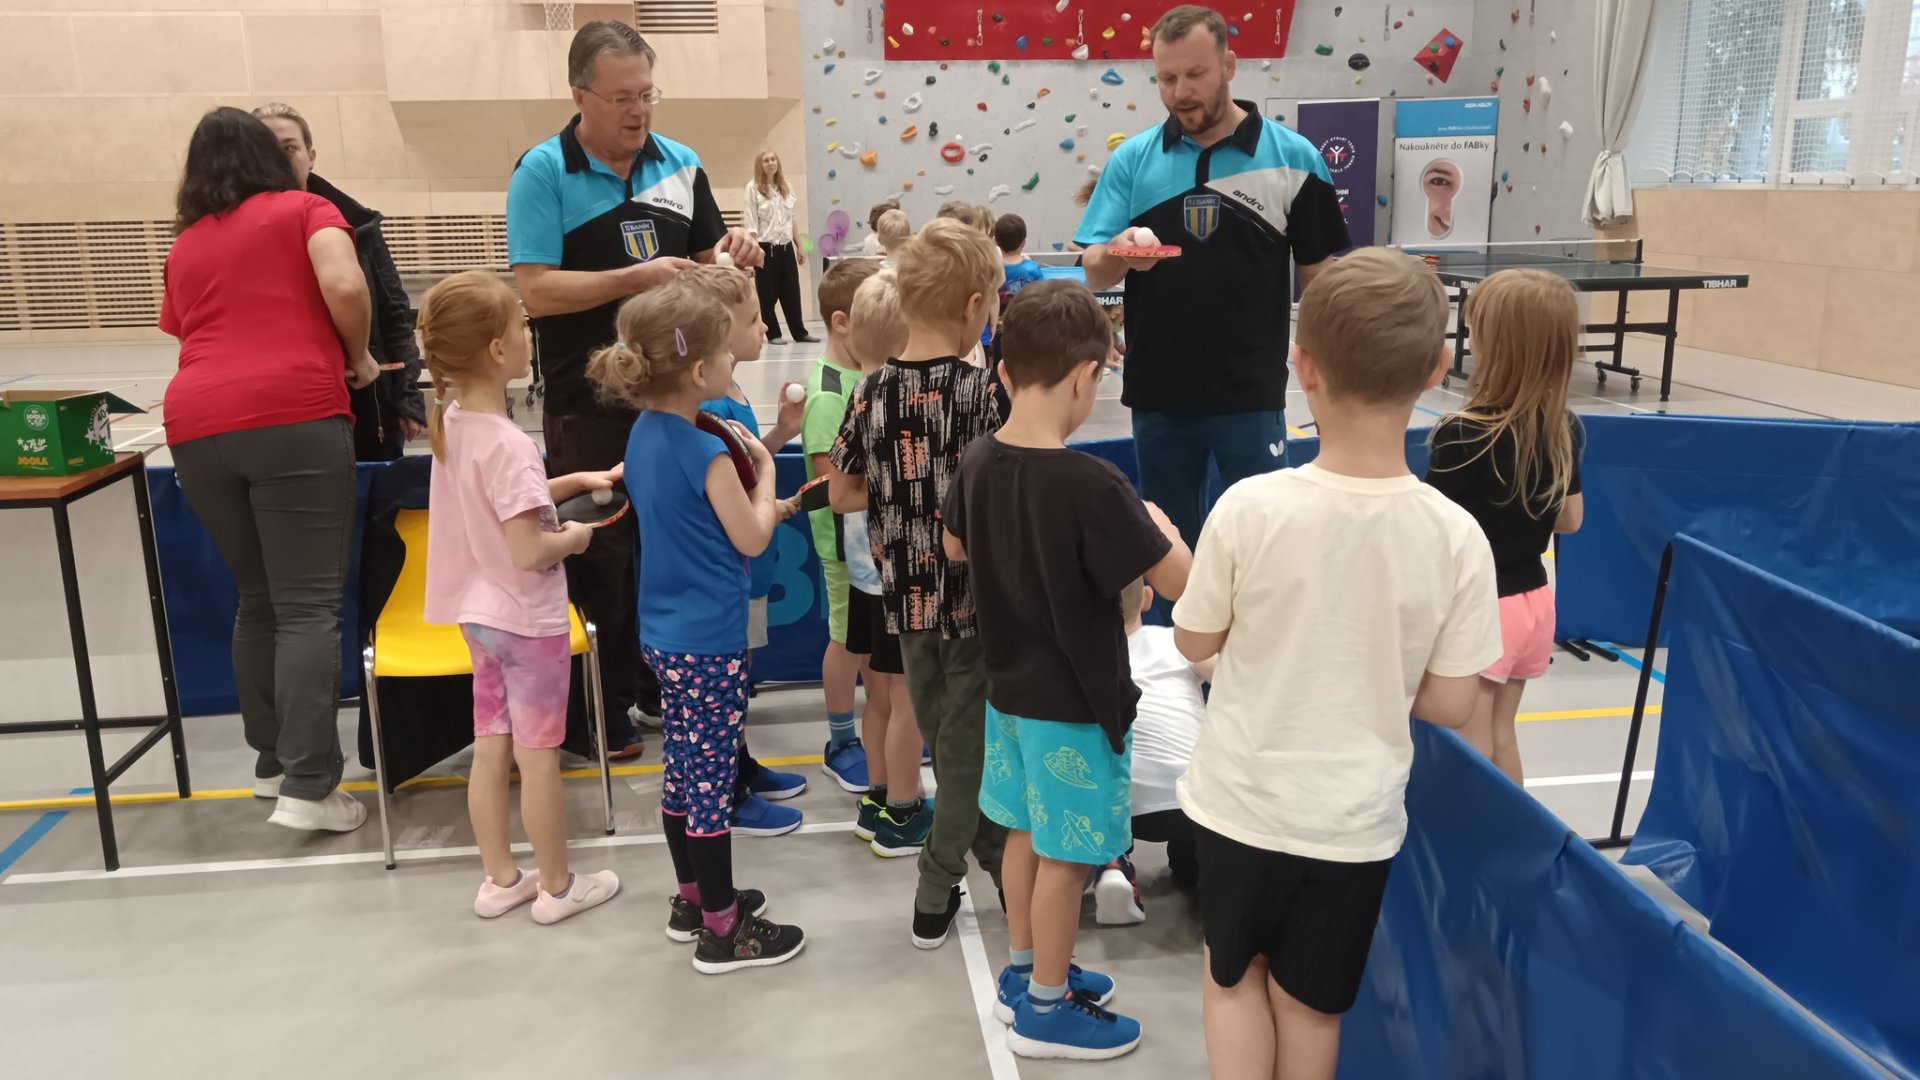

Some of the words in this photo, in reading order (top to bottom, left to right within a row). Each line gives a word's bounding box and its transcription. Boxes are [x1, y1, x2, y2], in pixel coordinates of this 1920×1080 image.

[1451, 141, 1462, 150] do
[1464, 141, 1490, 151] FABky
[652, 197, 684, 210] andro
[1233, 190, 1265, 211] andro
[1702, 279, 1738, 288] TIBHAR
[18, 457, 48, 466] JOOLA
